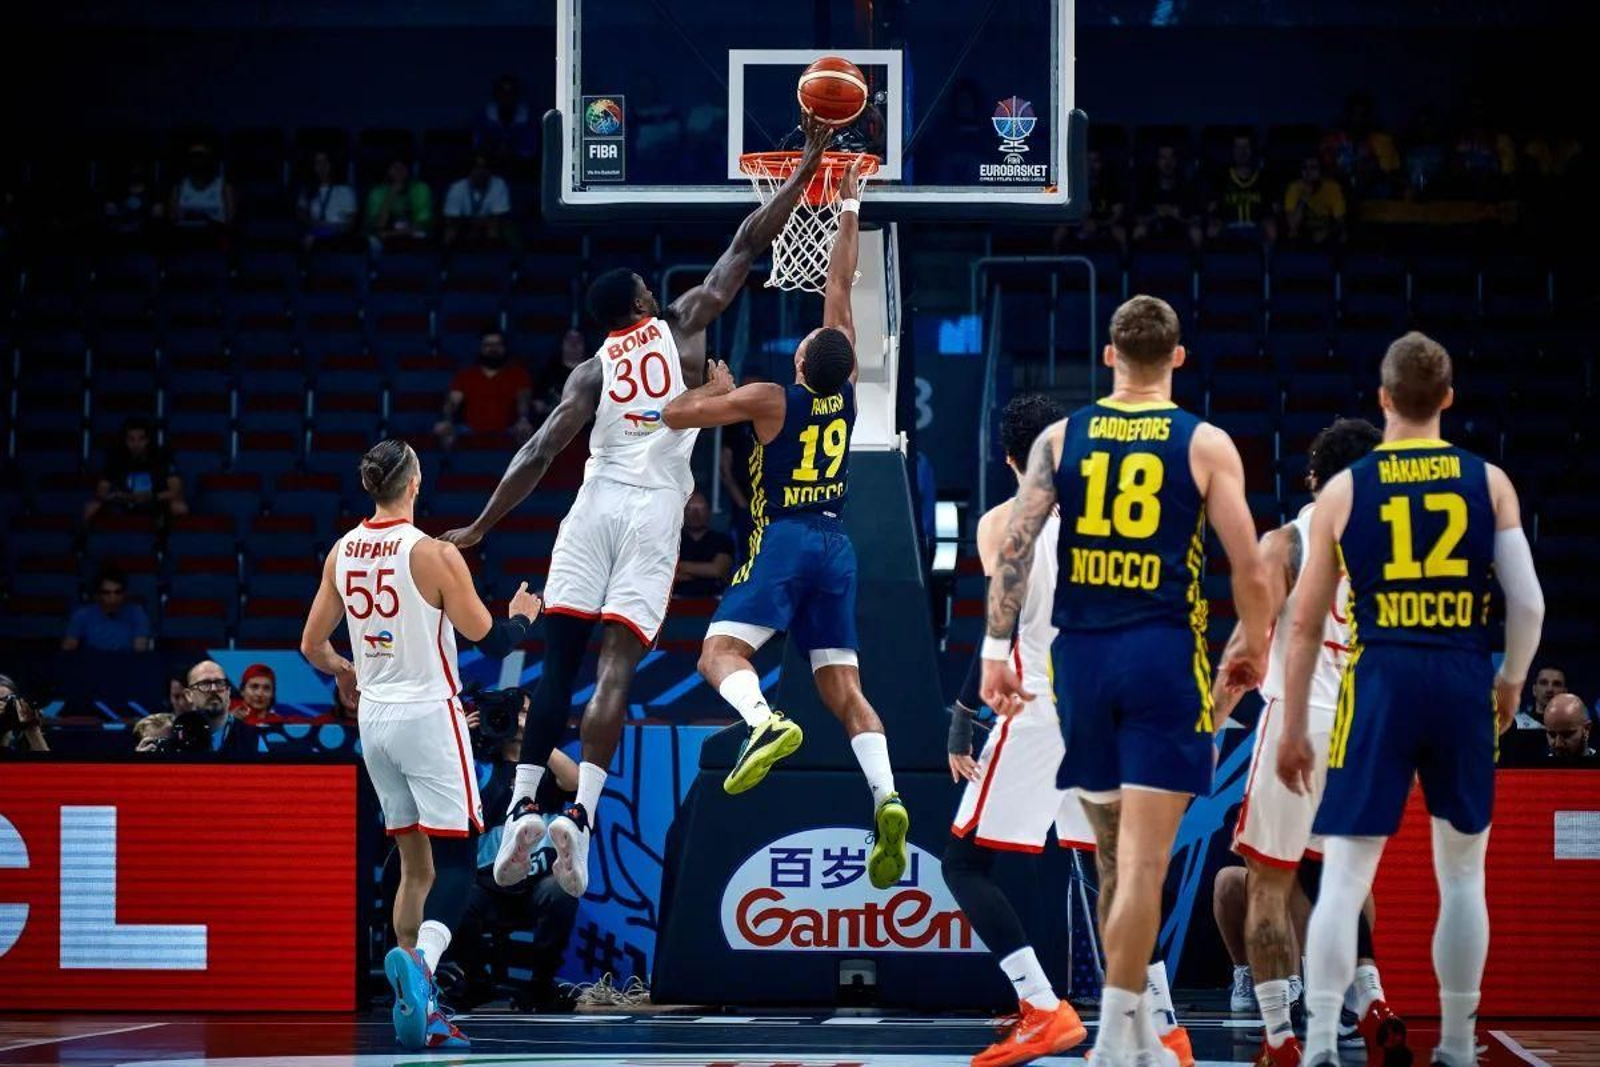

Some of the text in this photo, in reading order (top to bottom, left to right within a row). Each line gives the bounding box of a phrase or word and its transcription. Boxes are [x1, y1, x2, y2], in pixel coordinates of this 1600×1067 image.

[589, 144, 618, 159] FIBA
[980, 164, 1048, 177] EUROBASKET
[607, 324, 662, 361] BONA
[608, 351, 671, 404] 30
[792, 418, 847, 482] 19
[1088, 416, 1173, 442] GADDEFORS
[1378, 453, 1461, 484] HÅKANSON
[1075, 450, 1164, 539] 18
[1380, 492, 1469, 581] 12
[1070, 547, 1161, 590] NOCCO
[345, 568, 400, 620] 55
[1375, 591, 1474, 628] NOCCO
[0, 804, 207, 970] L
